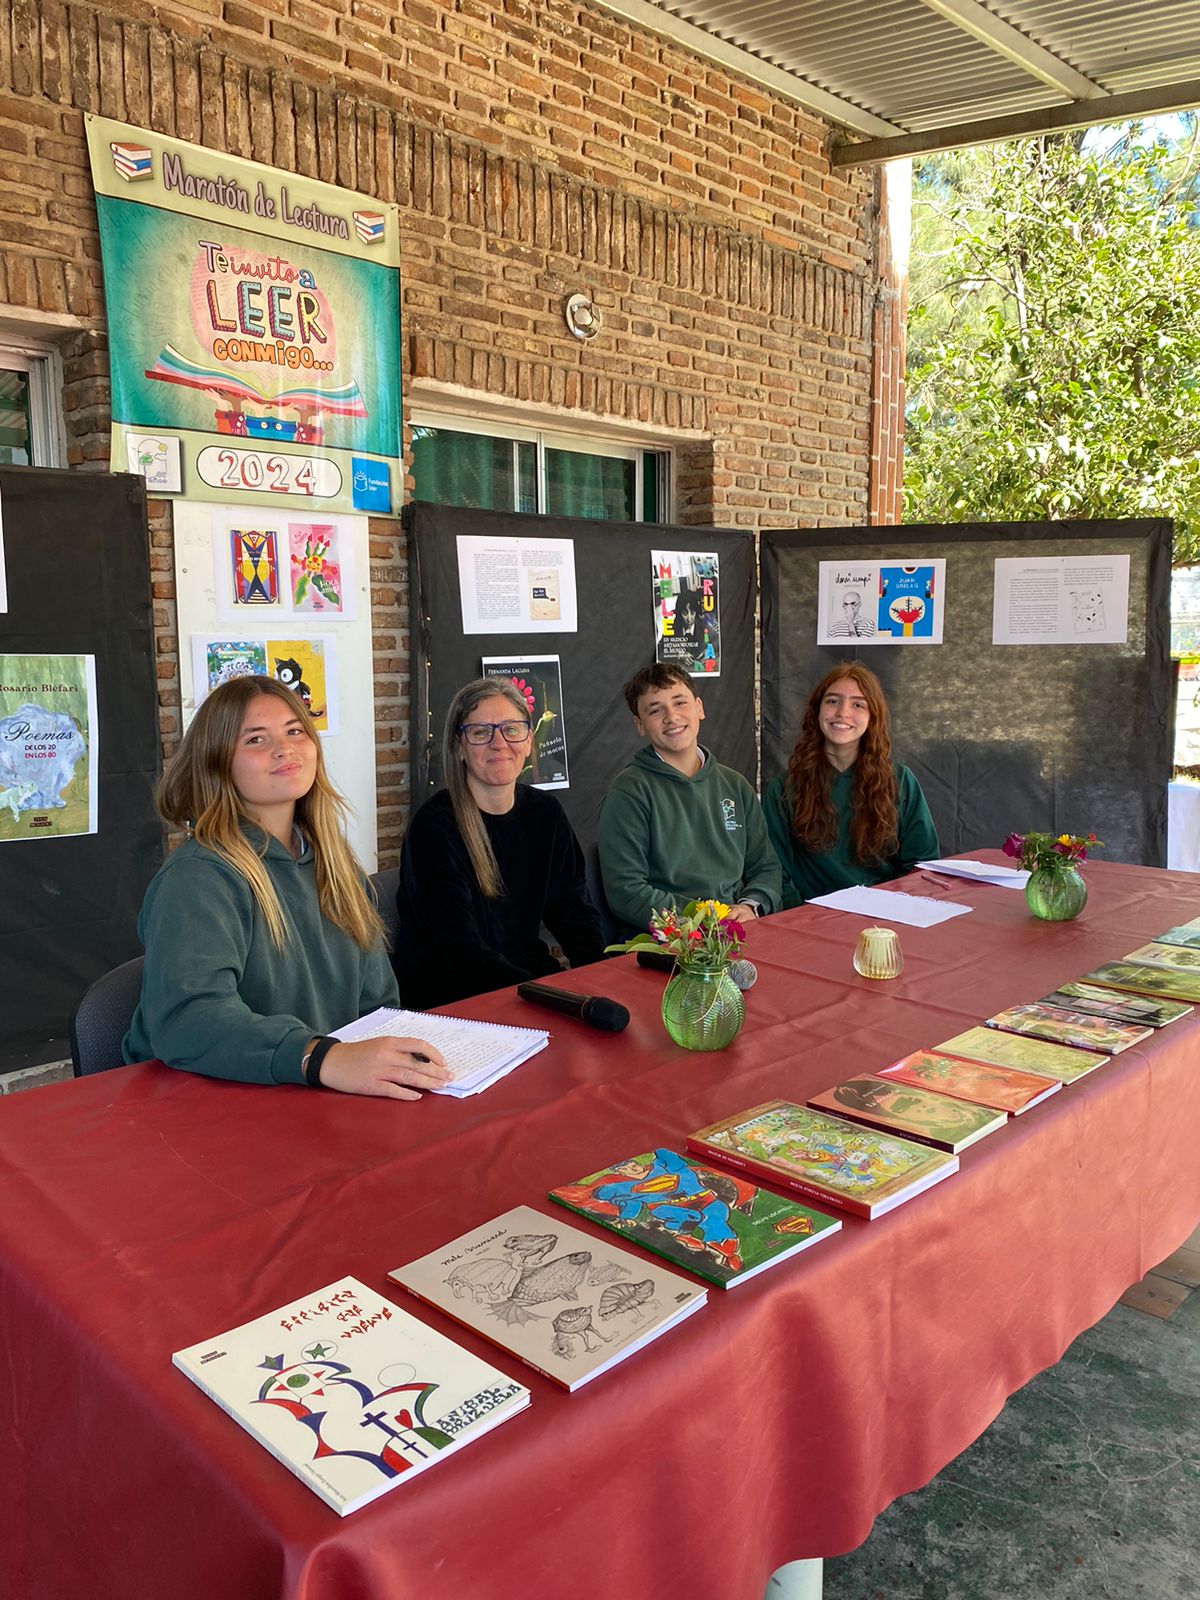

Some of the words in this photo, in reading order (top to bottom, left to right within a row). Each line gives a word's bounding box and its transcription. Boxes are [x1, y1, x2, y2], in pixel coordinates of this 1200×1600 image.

[162, 152, 249, 214] Maratón
[254, 190, 276, 219] de
[281, 187, 350, 240] Lectura
[199, 240, 229, 274] Te
[229, 256, 298, 283] invito
[298, 266, 319, 290] a
[206, 279, 328, 345] LEER
[217, 449, 318, 495] 2024
[41, 683, 79, 693] Blefari
[4, 720, 74, 742] Poemas
